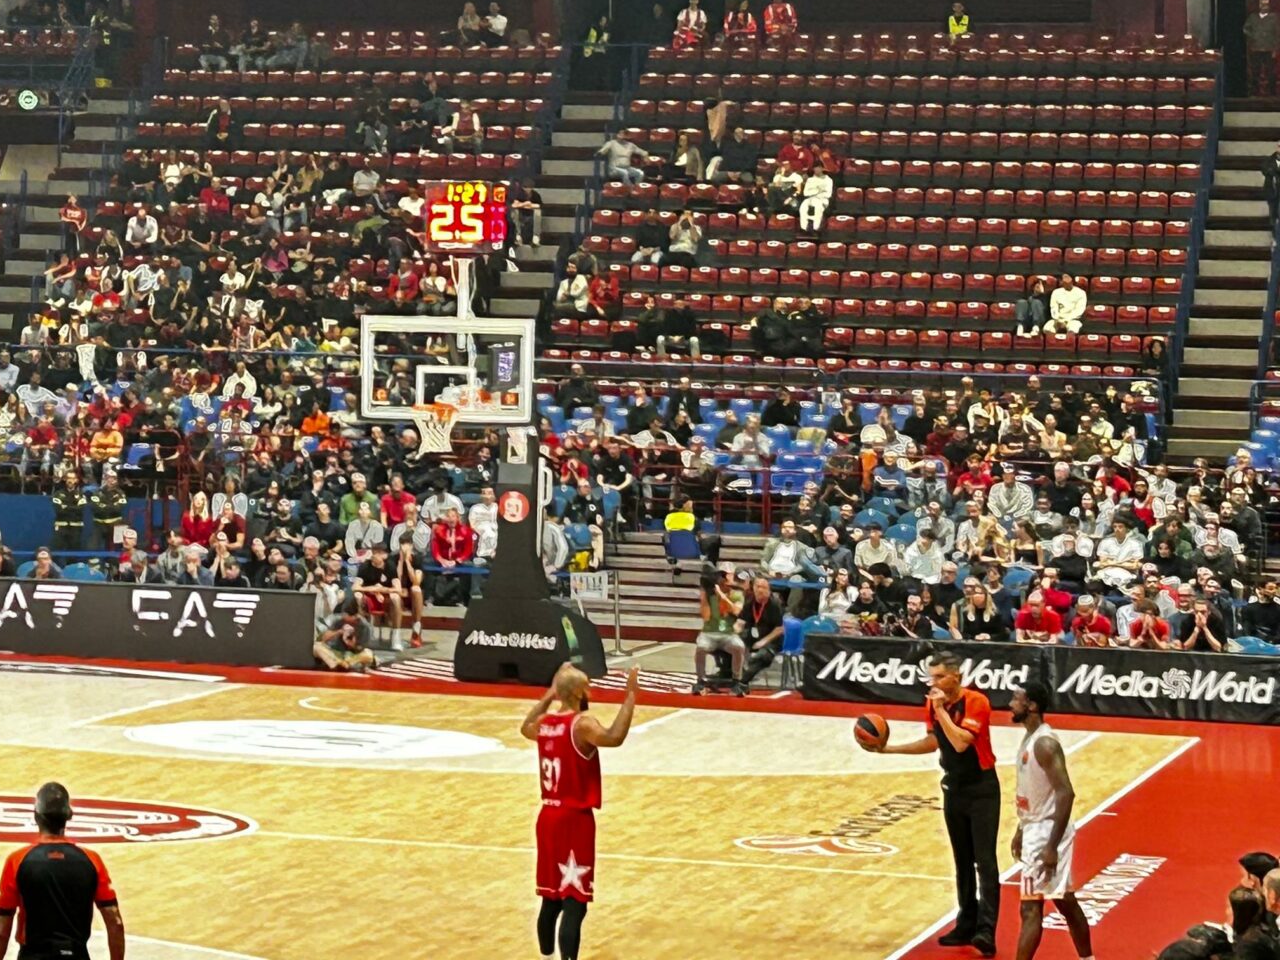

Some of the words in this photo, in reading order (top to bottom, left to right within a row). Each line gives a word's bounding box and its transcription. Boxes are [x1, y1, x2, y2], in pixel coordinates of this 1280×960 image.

[816, 651, 916, 685] Media
[1057, 663, 1159, 698] Media
[1188, 669, 1276, 705] World
[541, 757, 562, 793] 31
